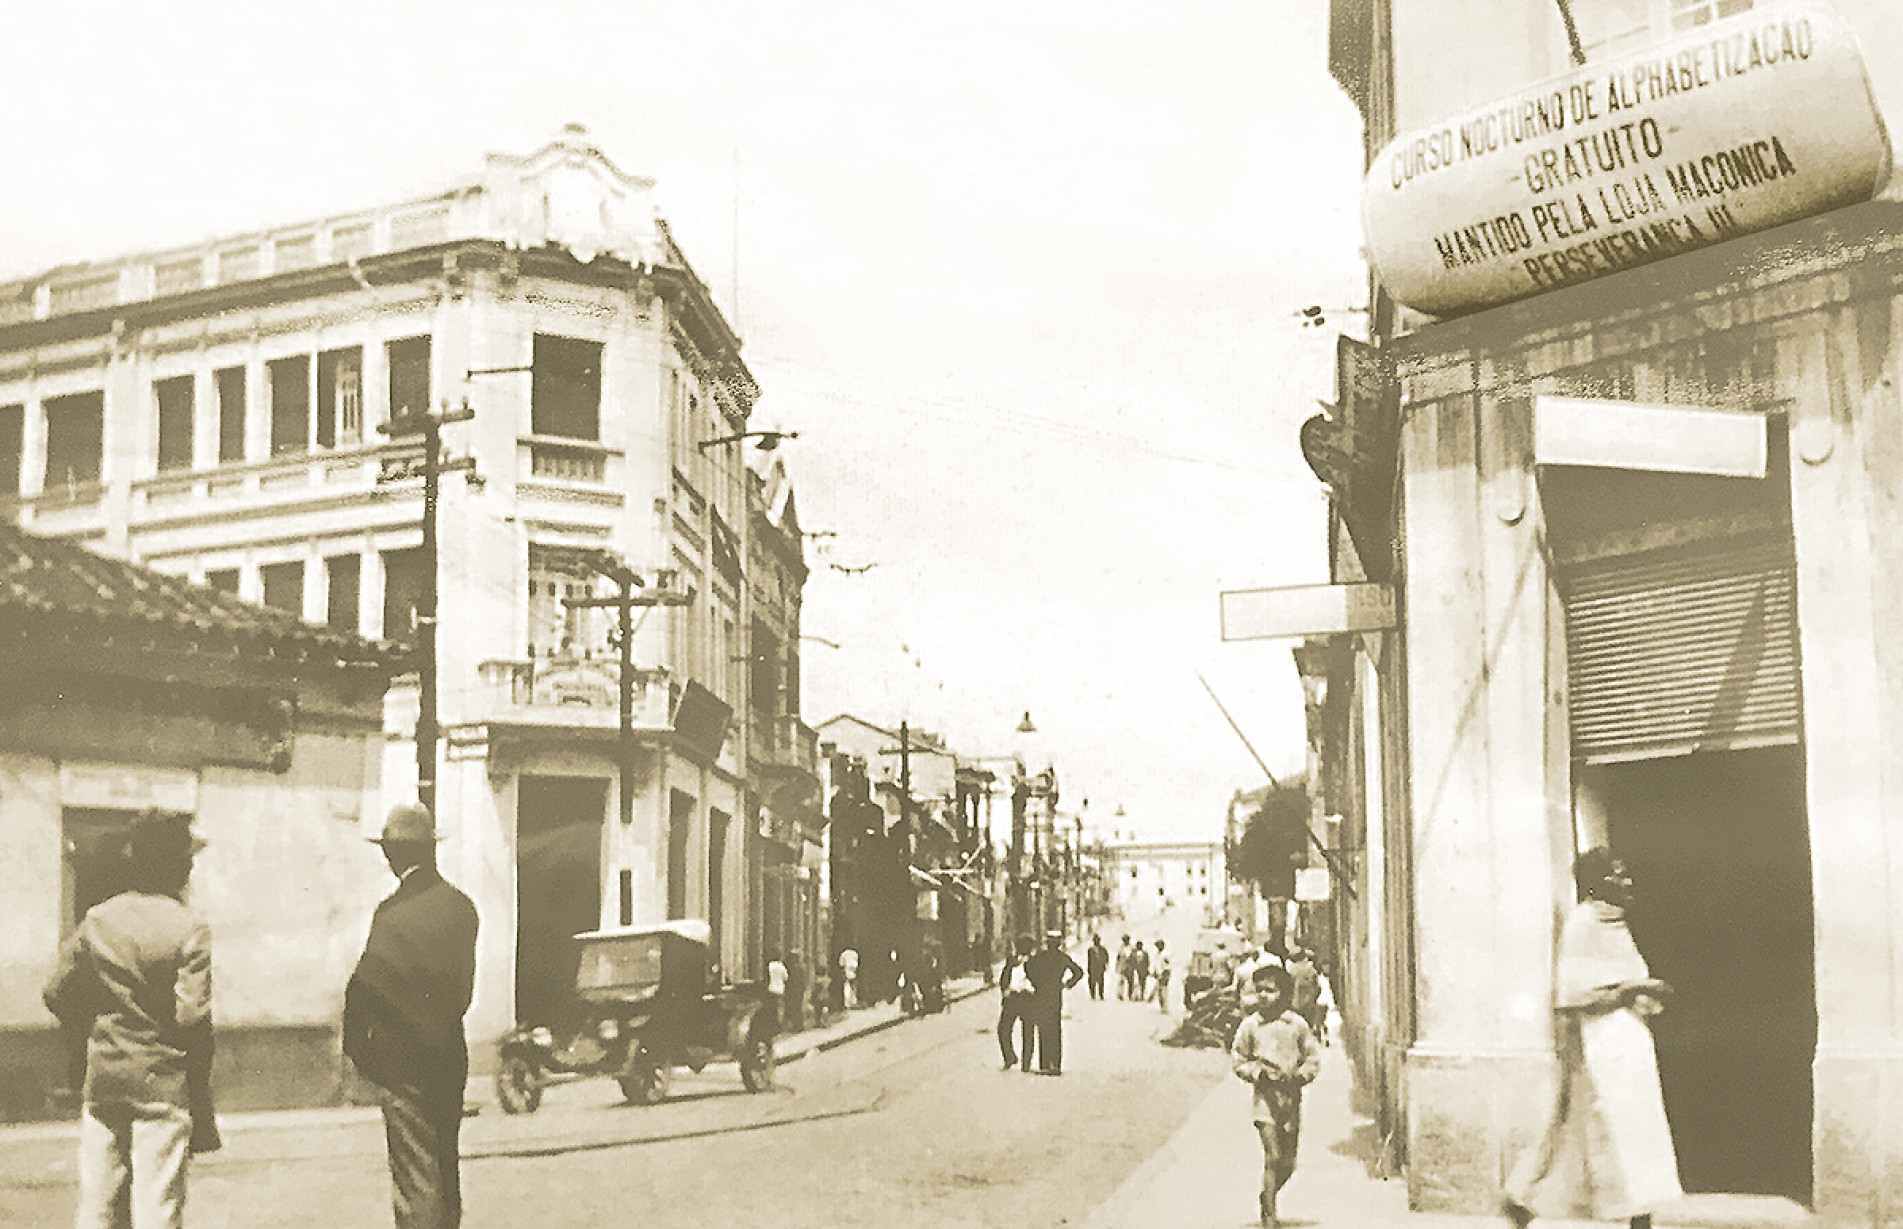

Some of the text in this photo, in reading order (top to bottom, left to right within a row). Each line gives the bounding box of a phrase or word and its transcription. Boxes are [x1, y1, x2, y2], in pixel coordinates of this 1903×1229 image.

[1392, 128, 1452, 189] CURSO
[1460, 92, 1564, 161] NOCTURNO
[1570, 80, 1599, 125] DE
[1434, 211, 1532, 269] MANTIDO
[1532, 192, 1598, 243] PELA
[1599, 173, 1666, 224] LOJA
